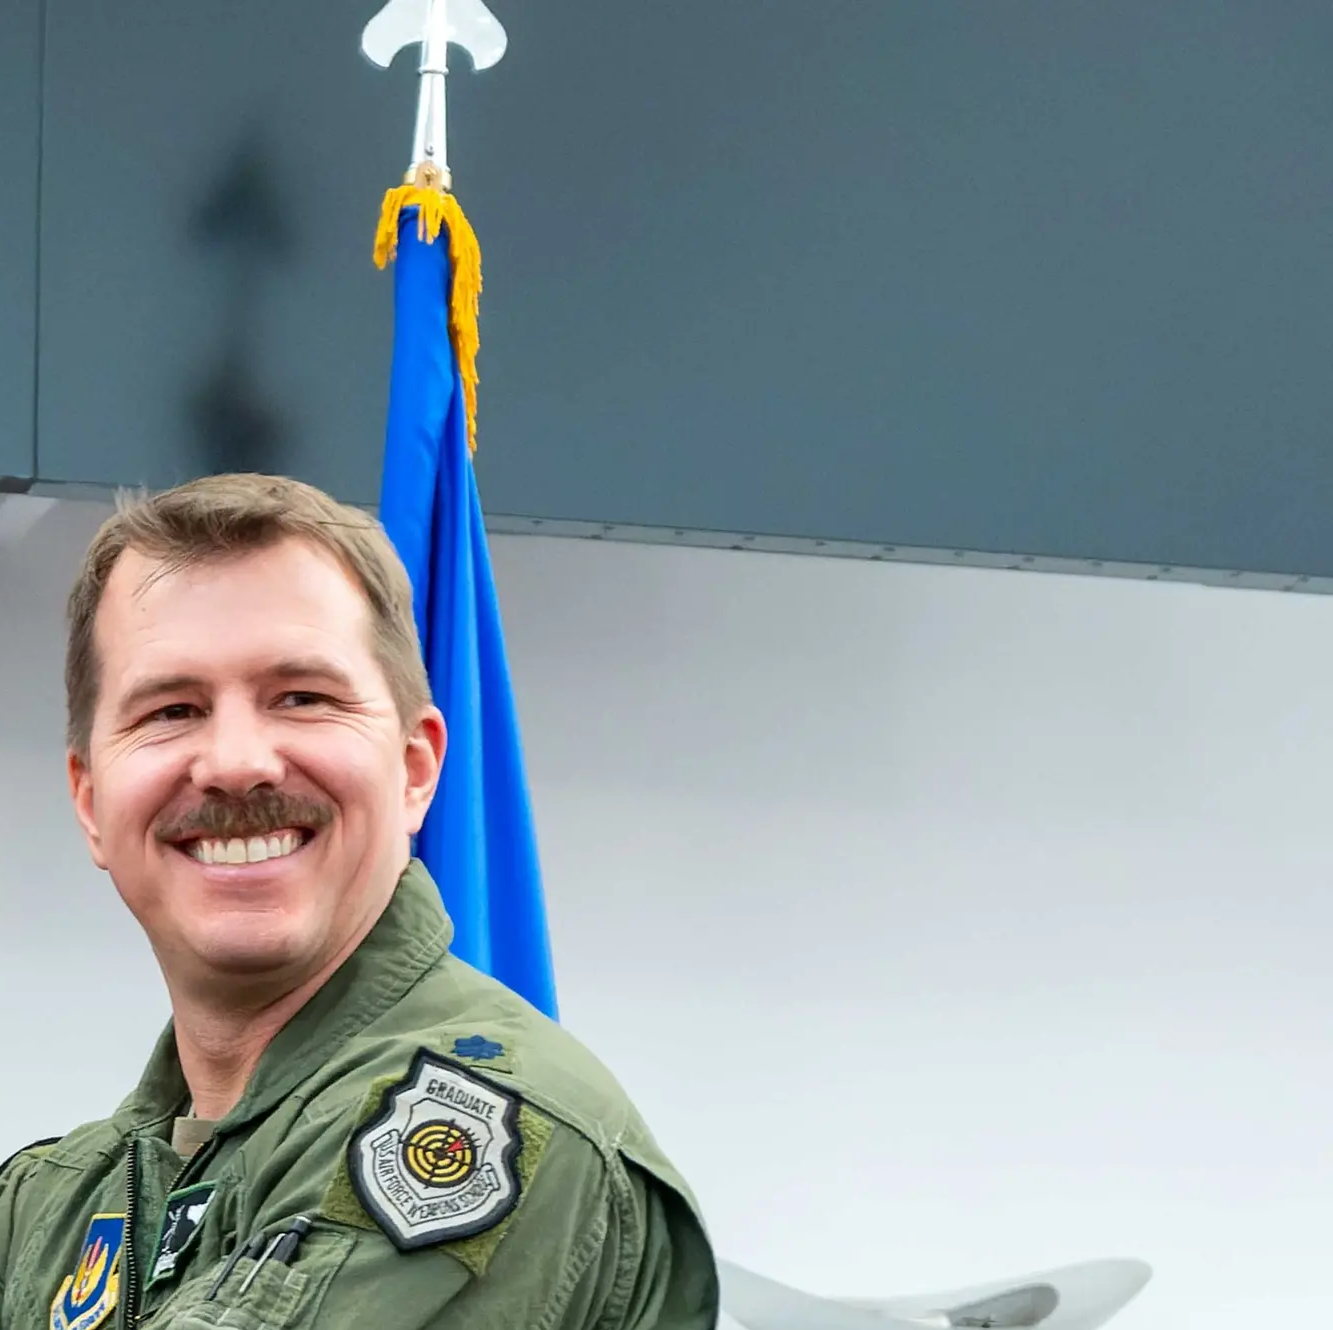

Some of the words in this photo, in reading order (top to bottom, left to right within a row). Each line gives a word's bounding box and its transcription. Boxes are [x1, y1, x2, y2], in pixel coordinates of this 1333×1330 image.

[426, 1078, 496, 1120] GRADUATE
[378, 1159, 394, 1177] AIR
[386, 1175, 414, 1208] FORCE
